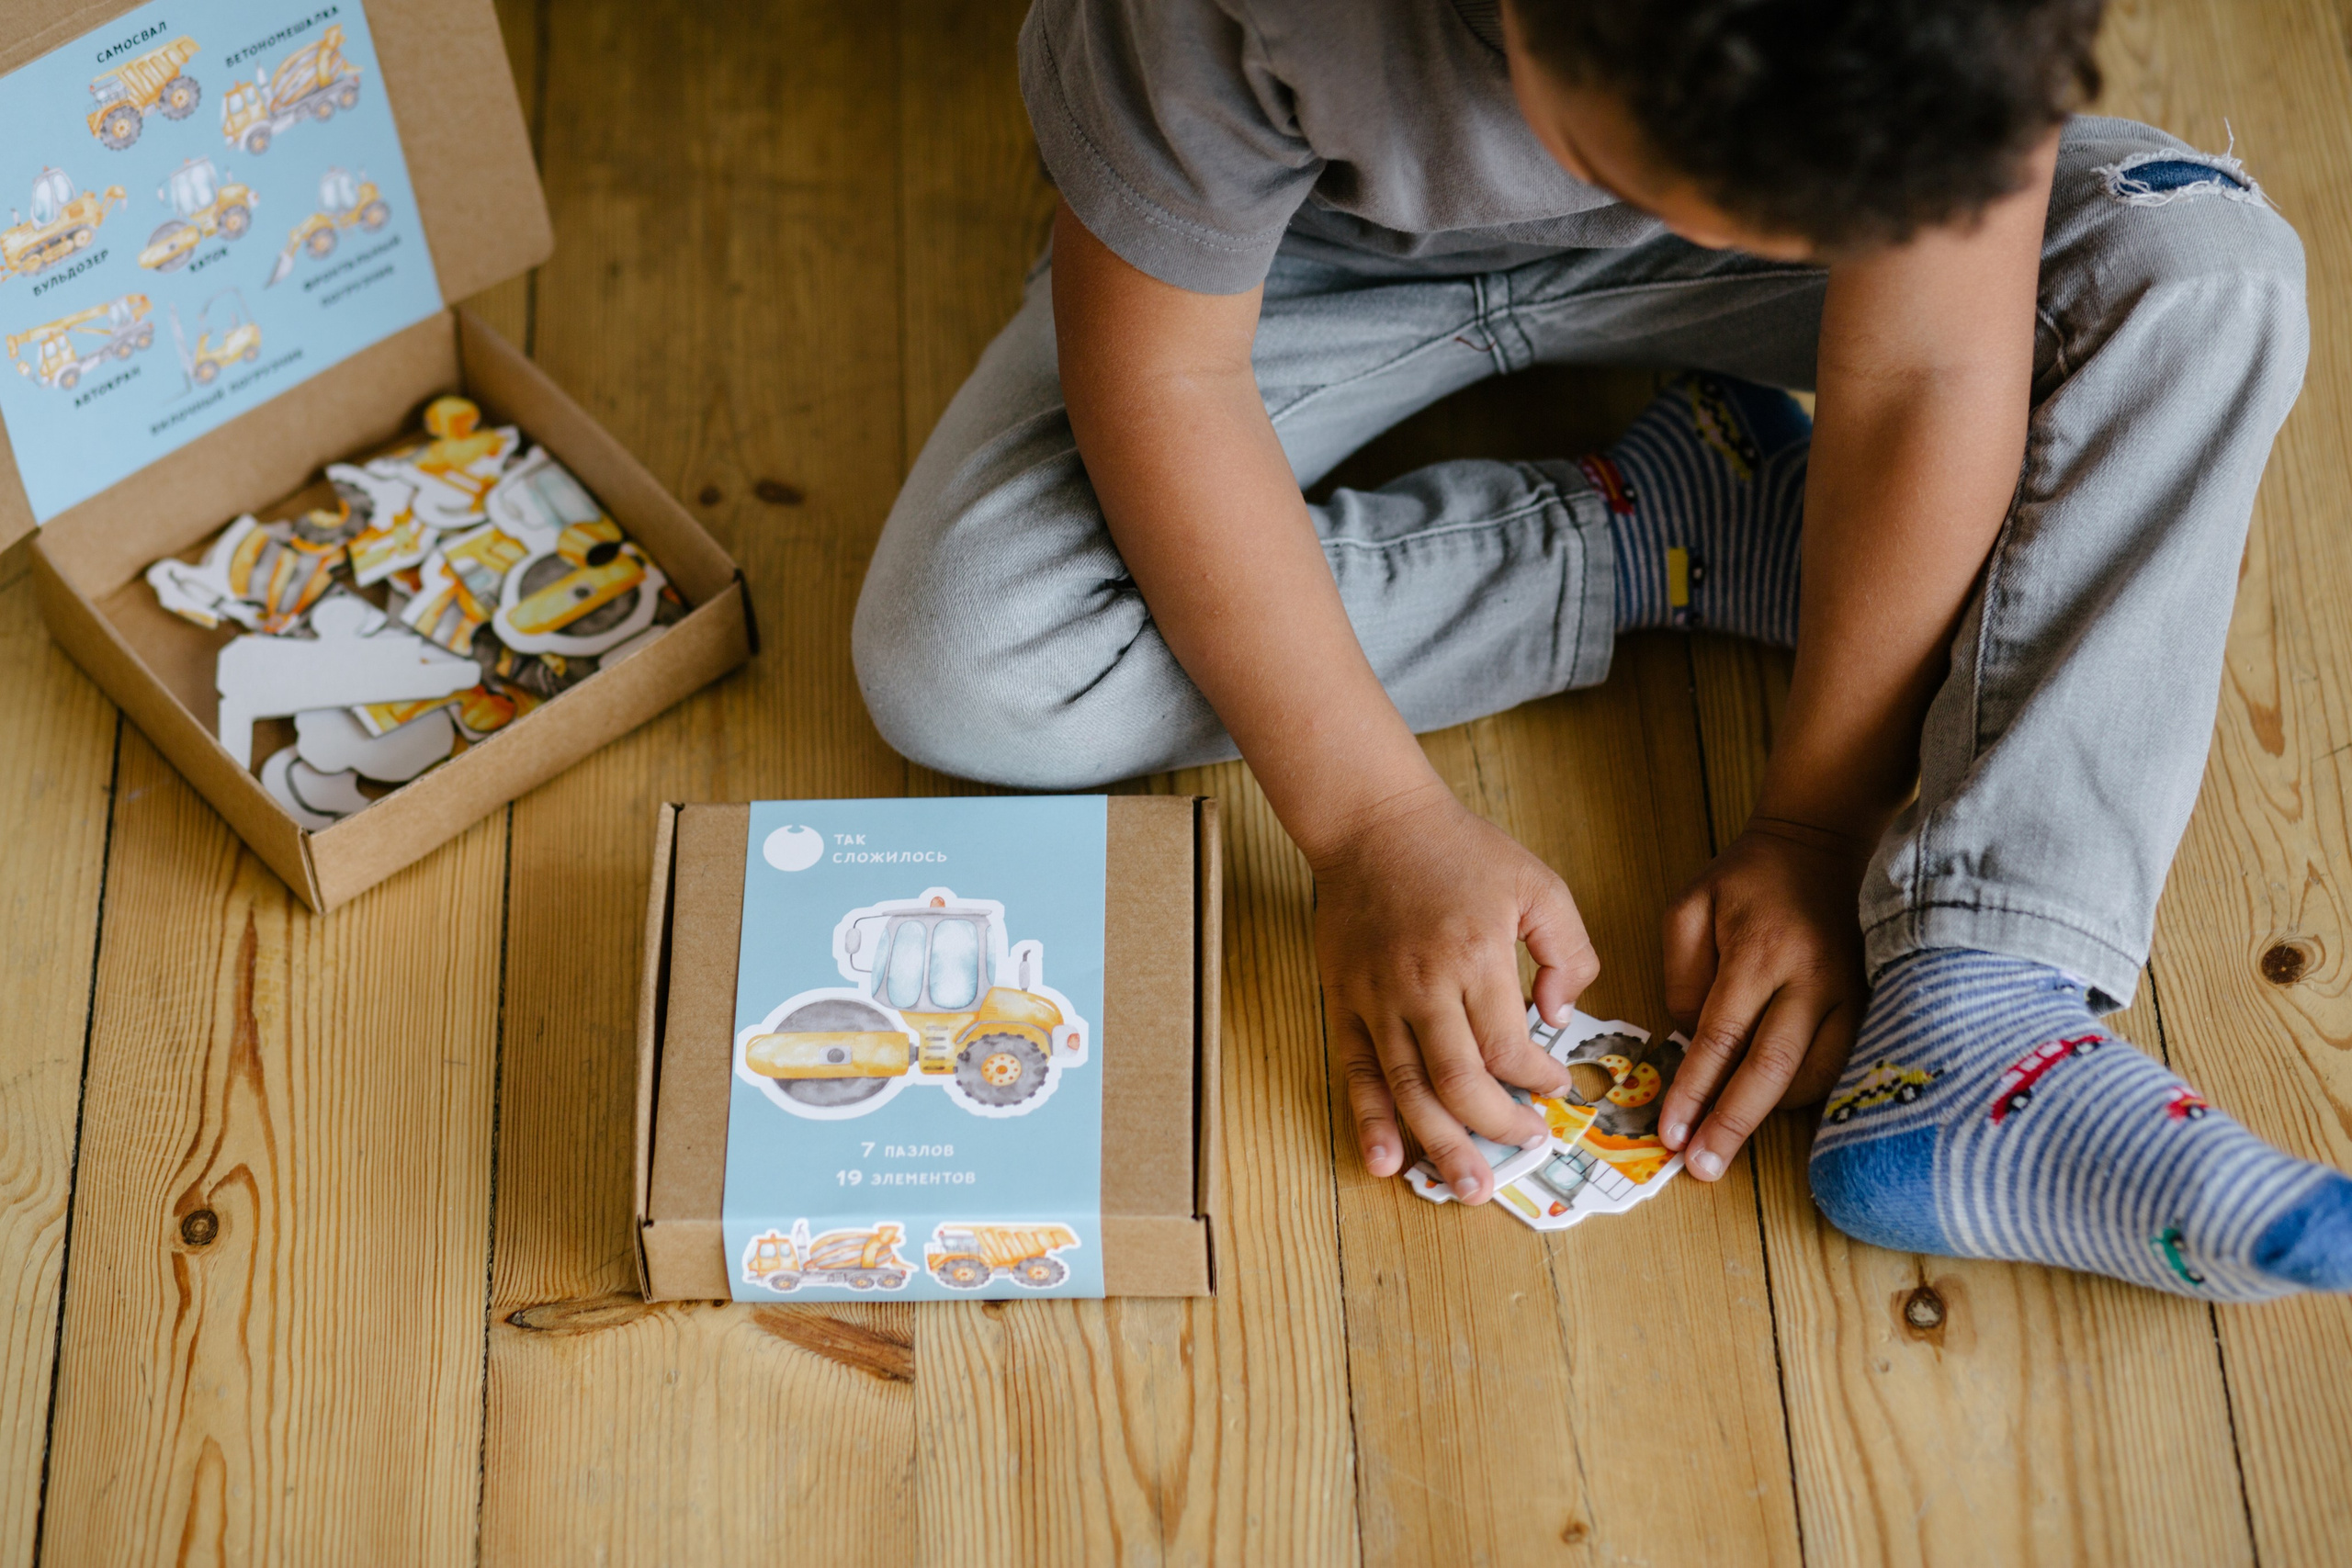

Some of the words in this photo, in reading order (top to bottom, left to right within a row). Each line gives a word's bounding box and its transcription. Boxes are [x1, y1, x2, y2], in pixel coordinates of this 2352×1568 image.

[96, 21, 167, 63] САМОСВАЛ
[226, 6, 339, 68] БЕТОНОМЕШАЛКА
[33, 249, 109, 297] БУЛЬДОЗЕР
[74, 366, 141, 410] АВТОКРАН
[833, 834, 866, 845] ТАК
[832, 851, 947, 863] СЛОЖИЛОСЬ
[861, 1142, 876, 1158] 7
[885, 1144, 955, 1157] ПАЗЛОВ
[836, 1169, 863, 1186] 19
[870, 1171, 976, 1186] ЭЛЕМЕНТОВ
